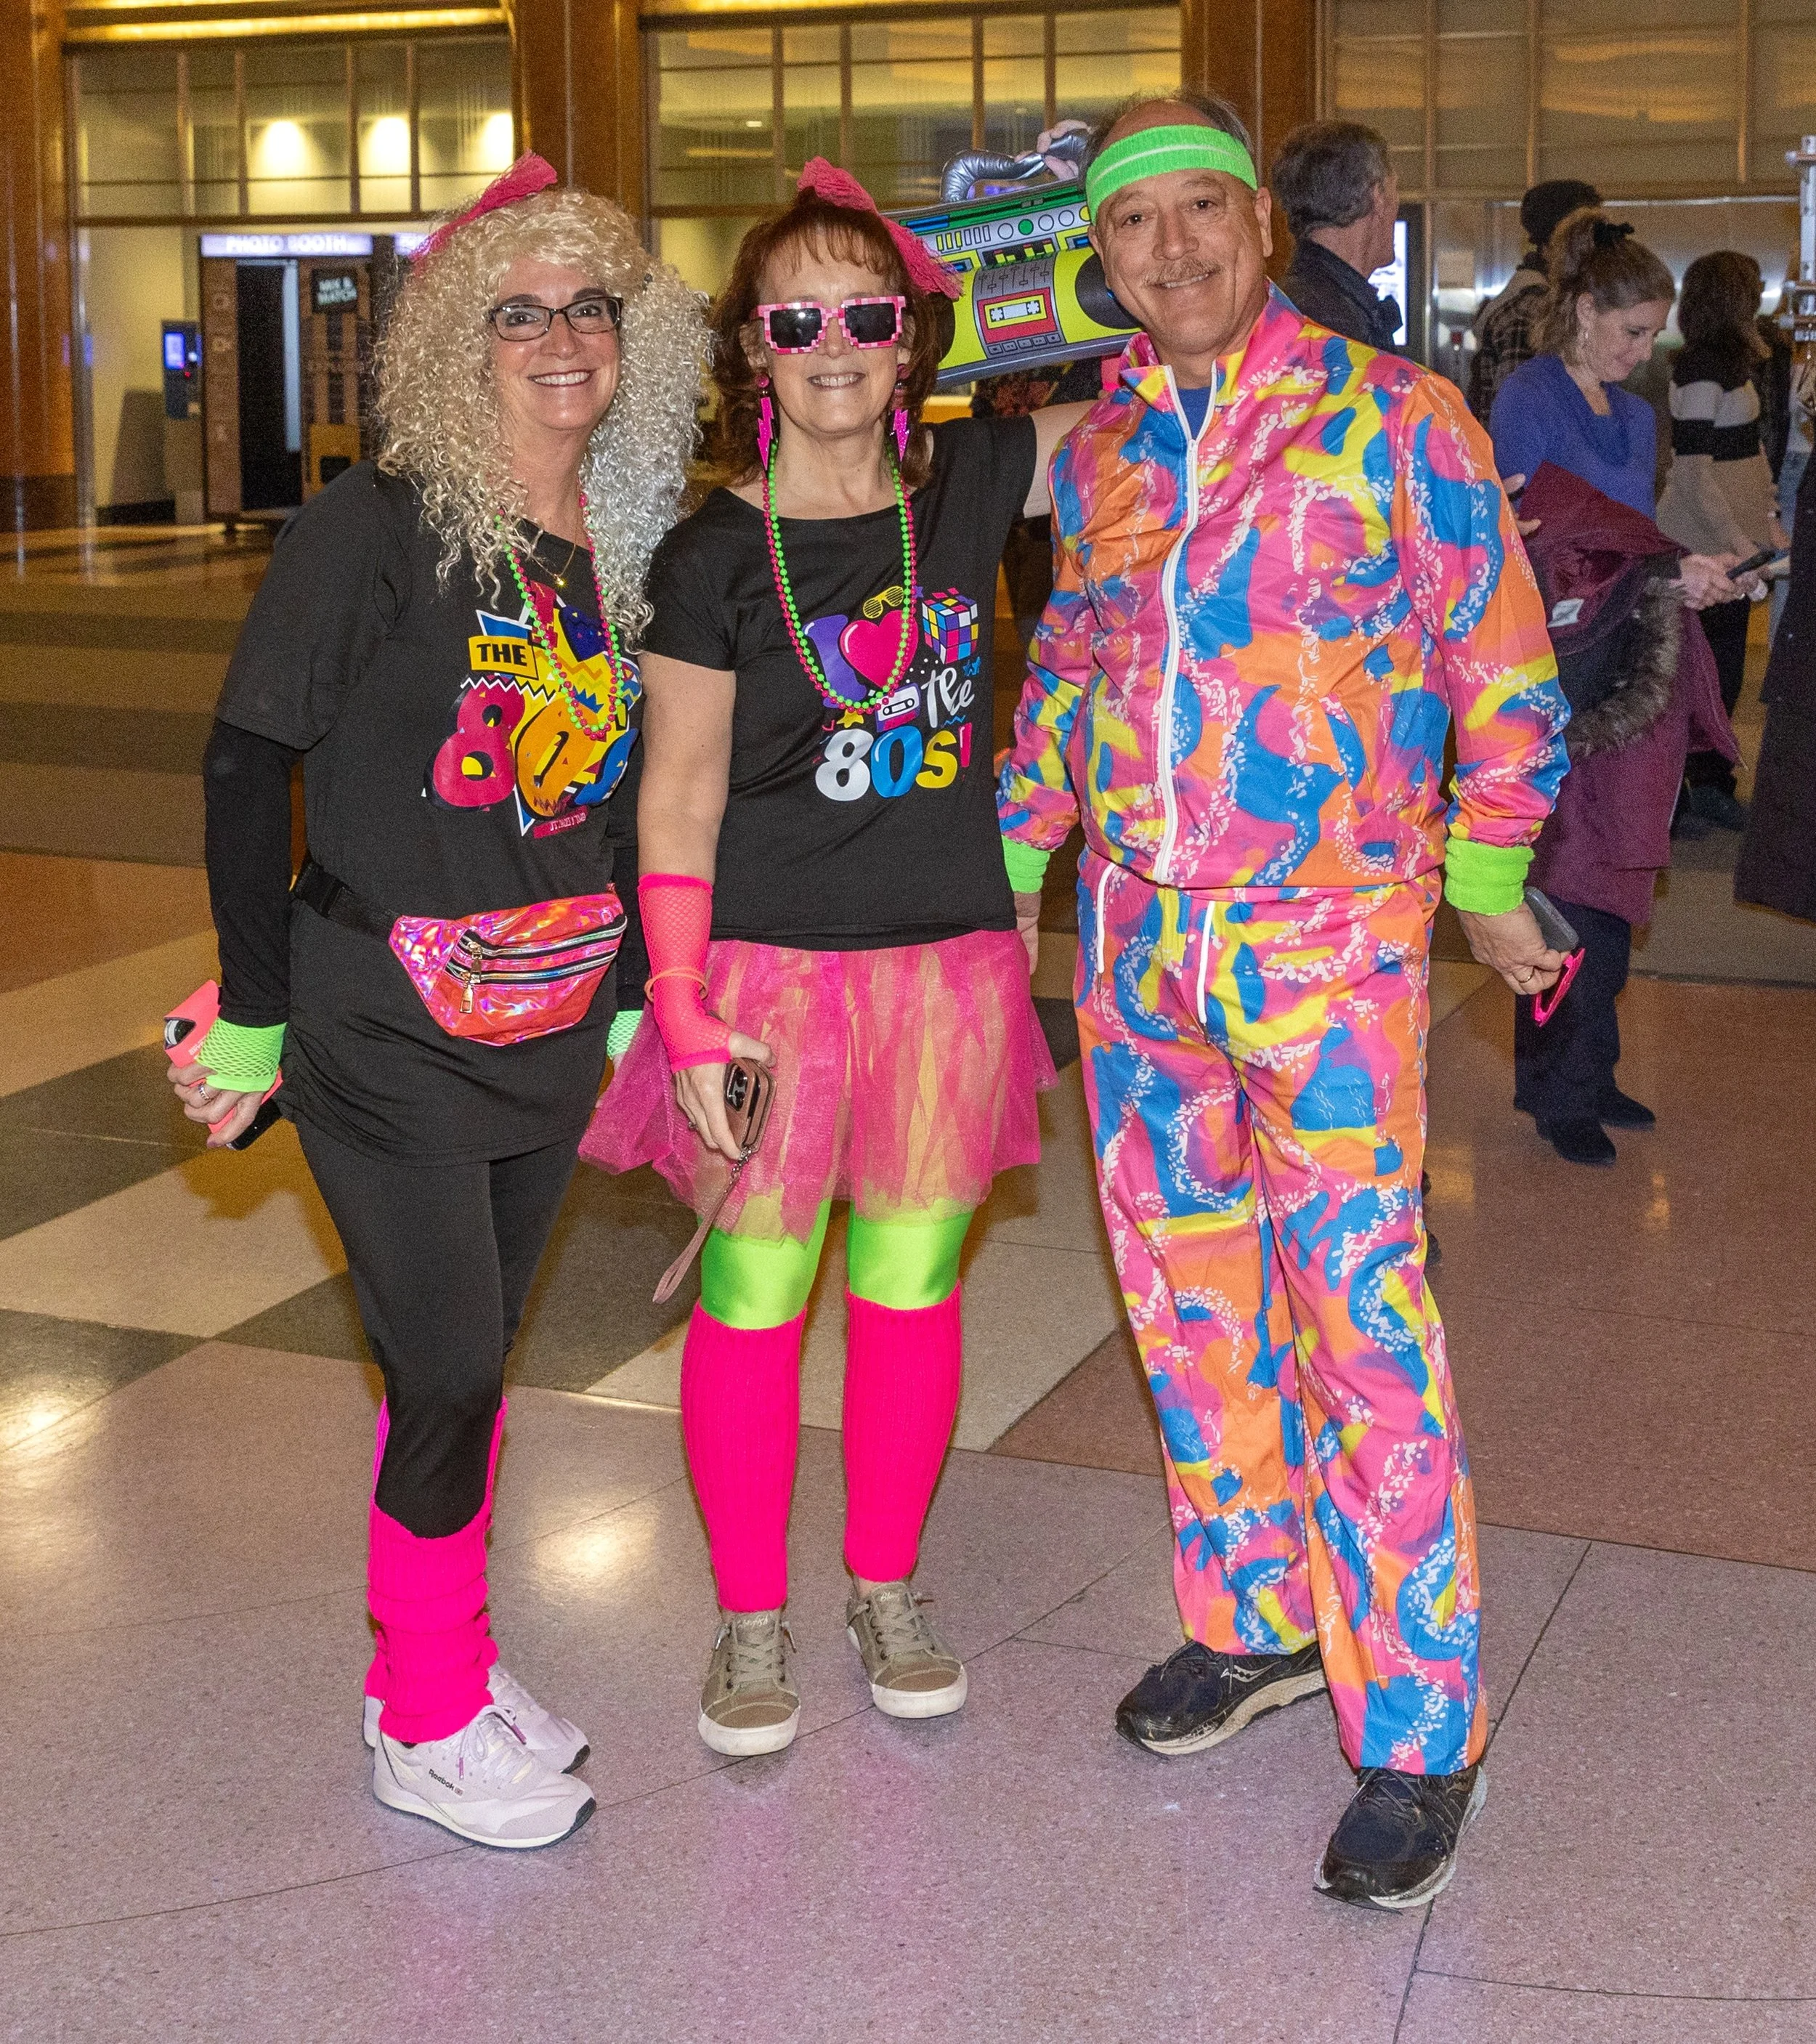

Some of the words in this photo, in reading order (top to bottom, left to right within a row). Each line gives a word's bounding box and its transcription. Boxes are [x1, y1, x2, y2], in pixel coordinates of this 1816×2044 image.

[226, 235, 283, 252] PHOTO
[288, 235, 347, 252] BOOTH
[476, 643, 528, 667] THE
[802, 614, 867, 709] I
[429, 1768, 455, 1792] Reebok
